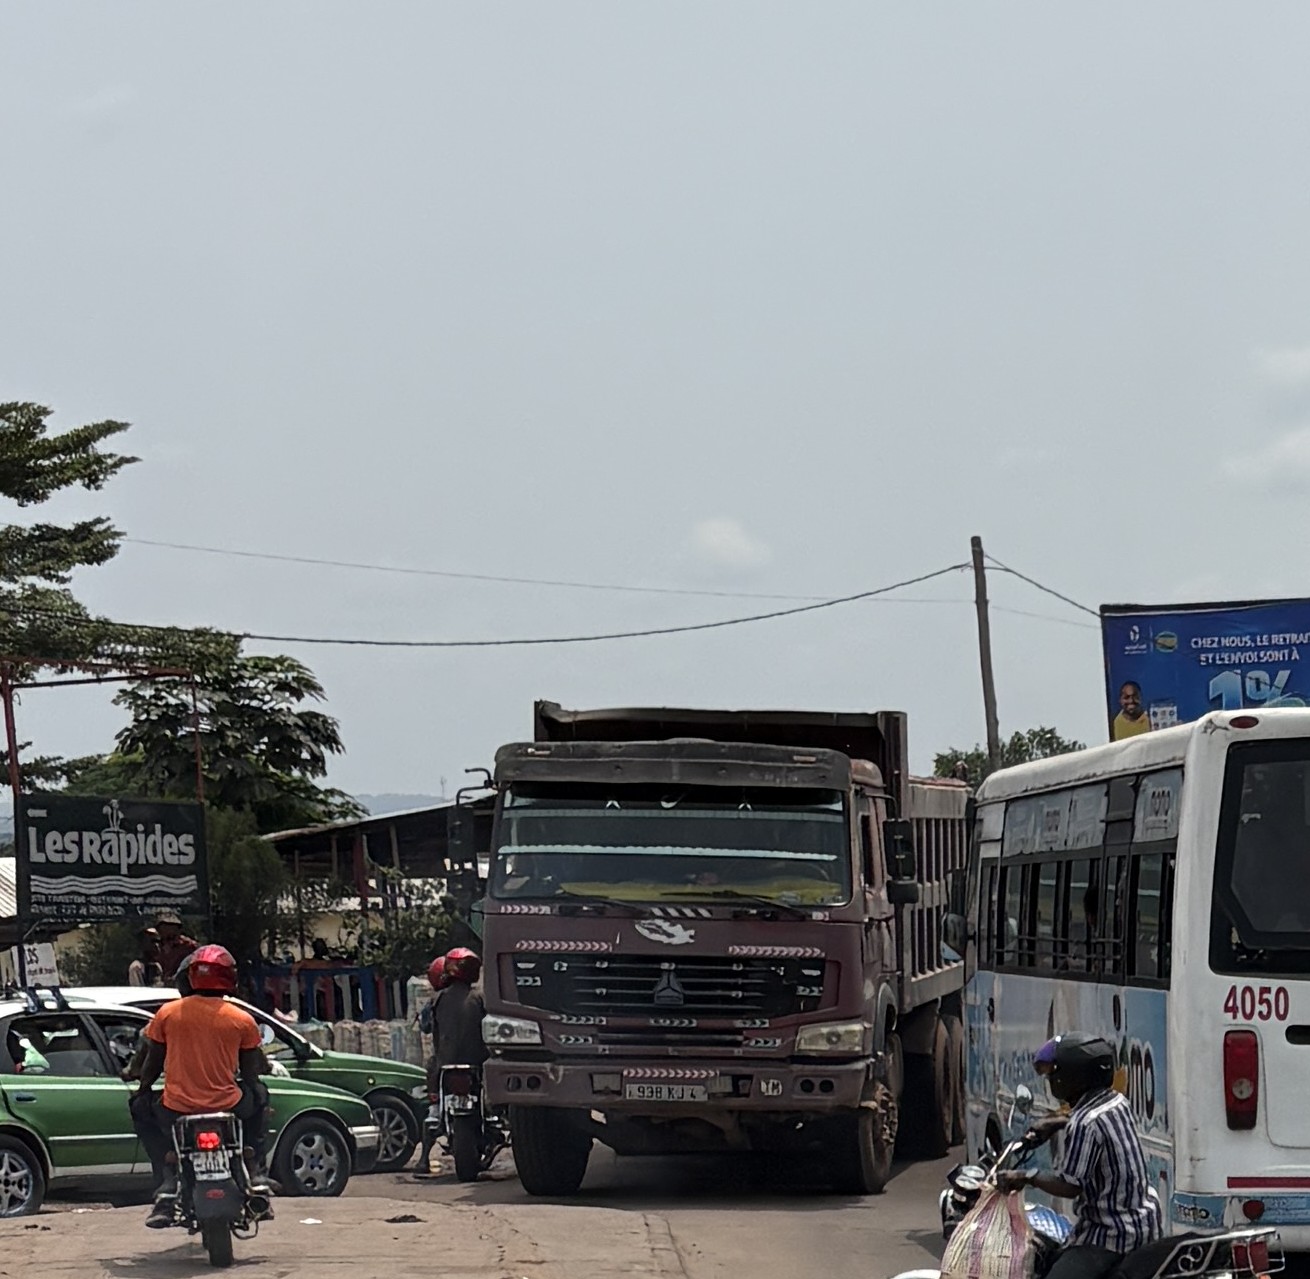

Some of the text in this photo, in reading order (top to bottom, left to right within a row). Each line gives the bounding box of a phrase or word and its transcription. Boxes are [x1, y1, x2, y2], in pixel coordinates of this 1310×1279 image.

[1191, 637, 1219, 648] CHEZ
[1221, 635, 1254, 648] NOUS,
[1256, 634, 1270, 646] LE
[1200, 653, 1213, 665] ET
[1259, 649, 1290, 662] SONT
[1223, 986, 1290, 1021] 4050
